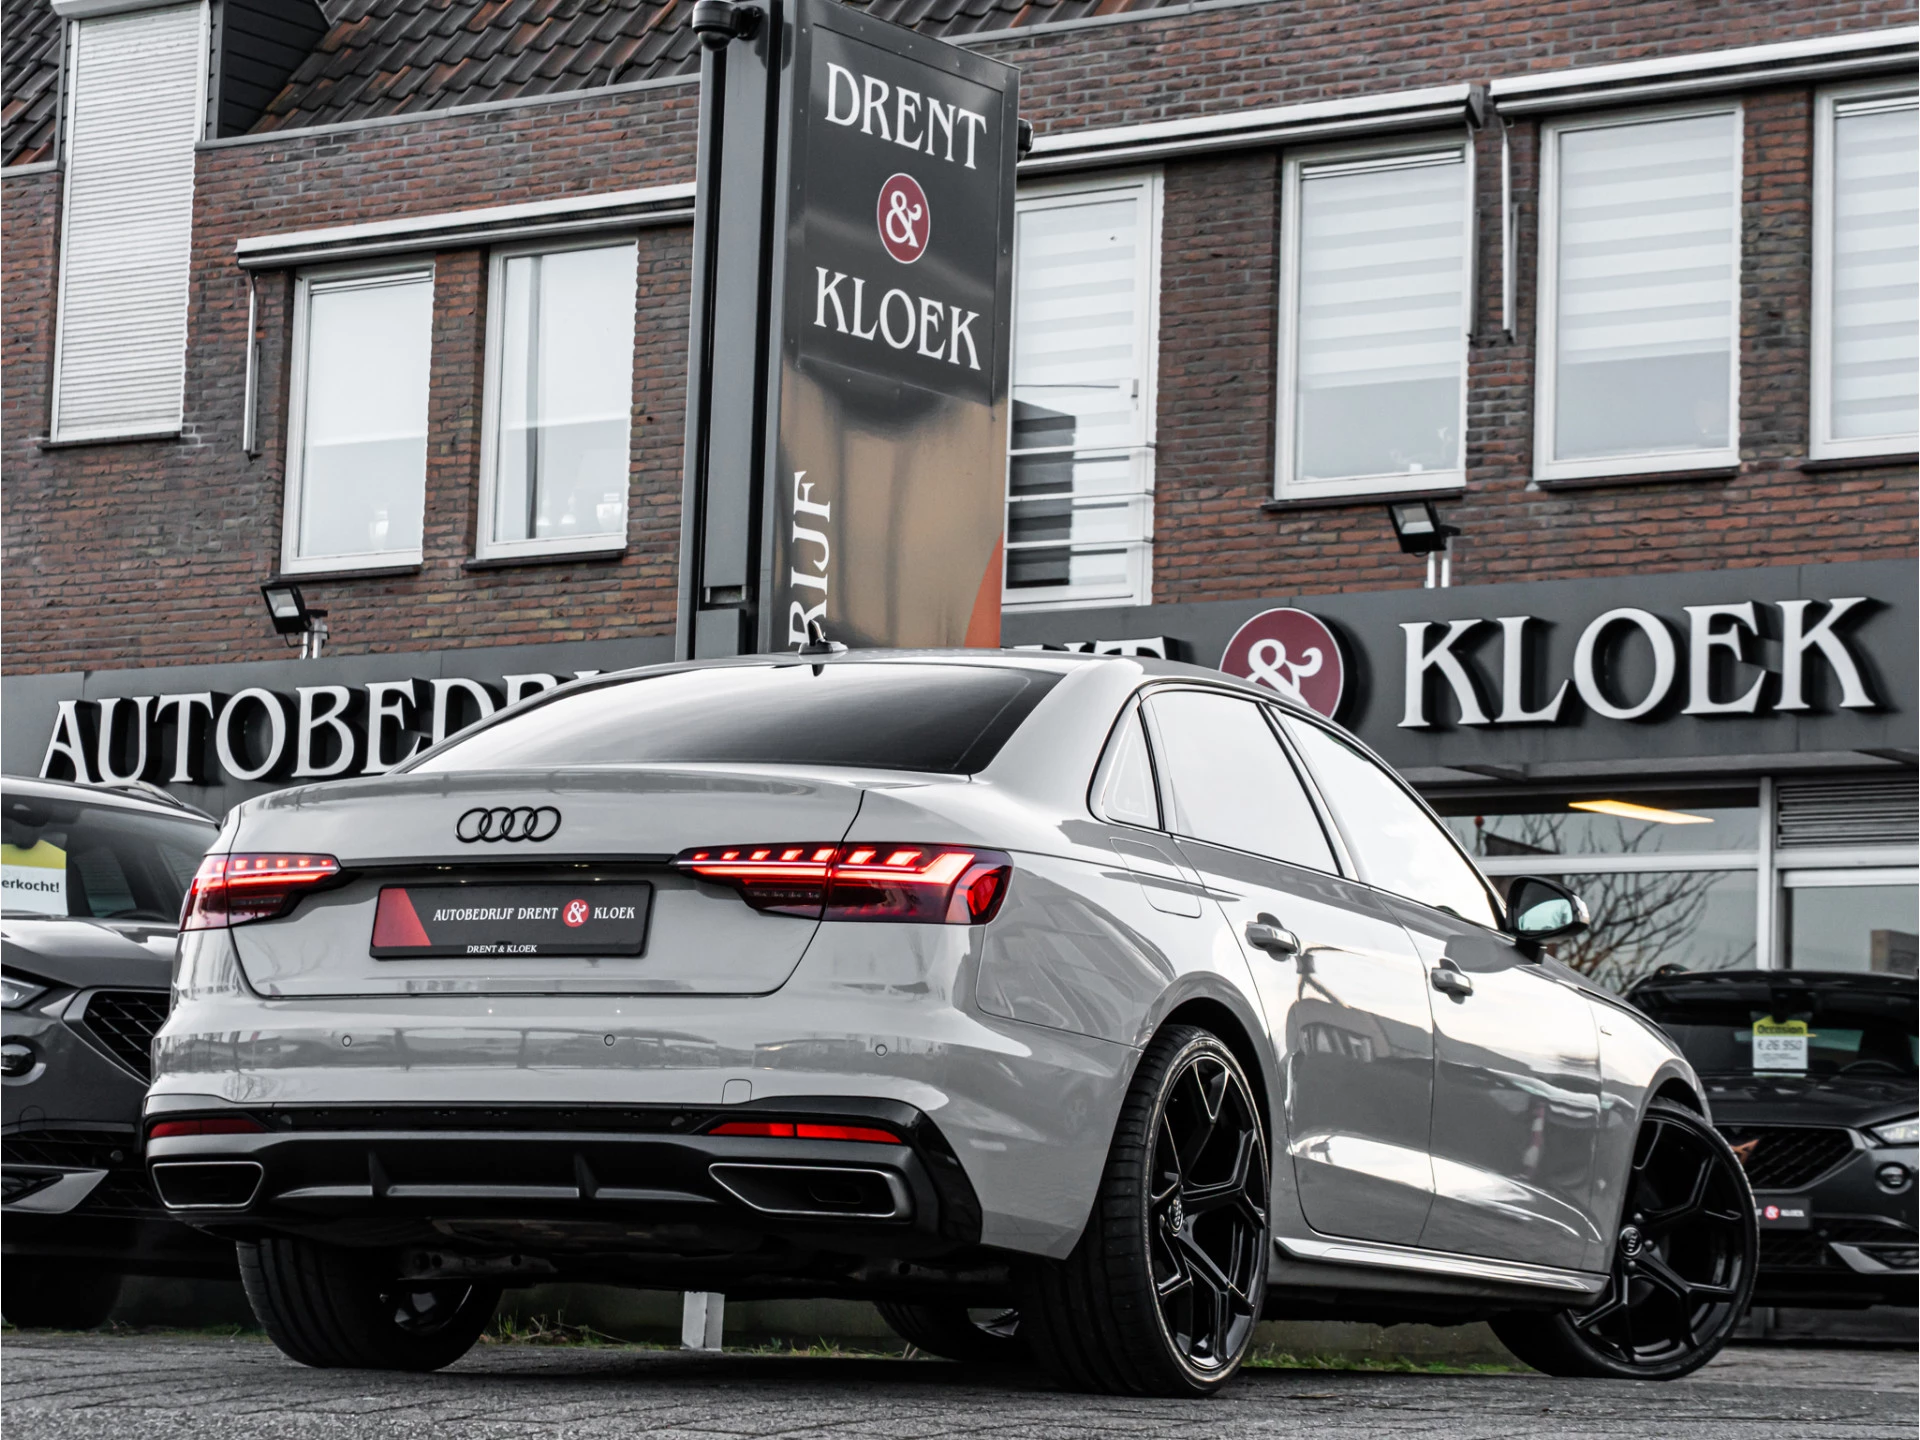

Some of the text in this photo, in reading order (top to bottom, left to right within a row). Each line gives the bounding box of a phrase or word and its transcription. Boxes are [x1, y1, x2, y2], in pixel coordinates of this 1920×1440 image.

[824, 61, 987, 170] DRENT
[885, 190, 921, 248] &
[814, 266, 981, 371] KLOEK
[39, 670, 600, 784] AUTOBED
[1398, 596, 1876, 728] KLOEK
[433, 901, 635, 923] AUTOBEDRIJF DRENT & KLOEK
[466, 944, 537, 954] DRENT & KLOEK
